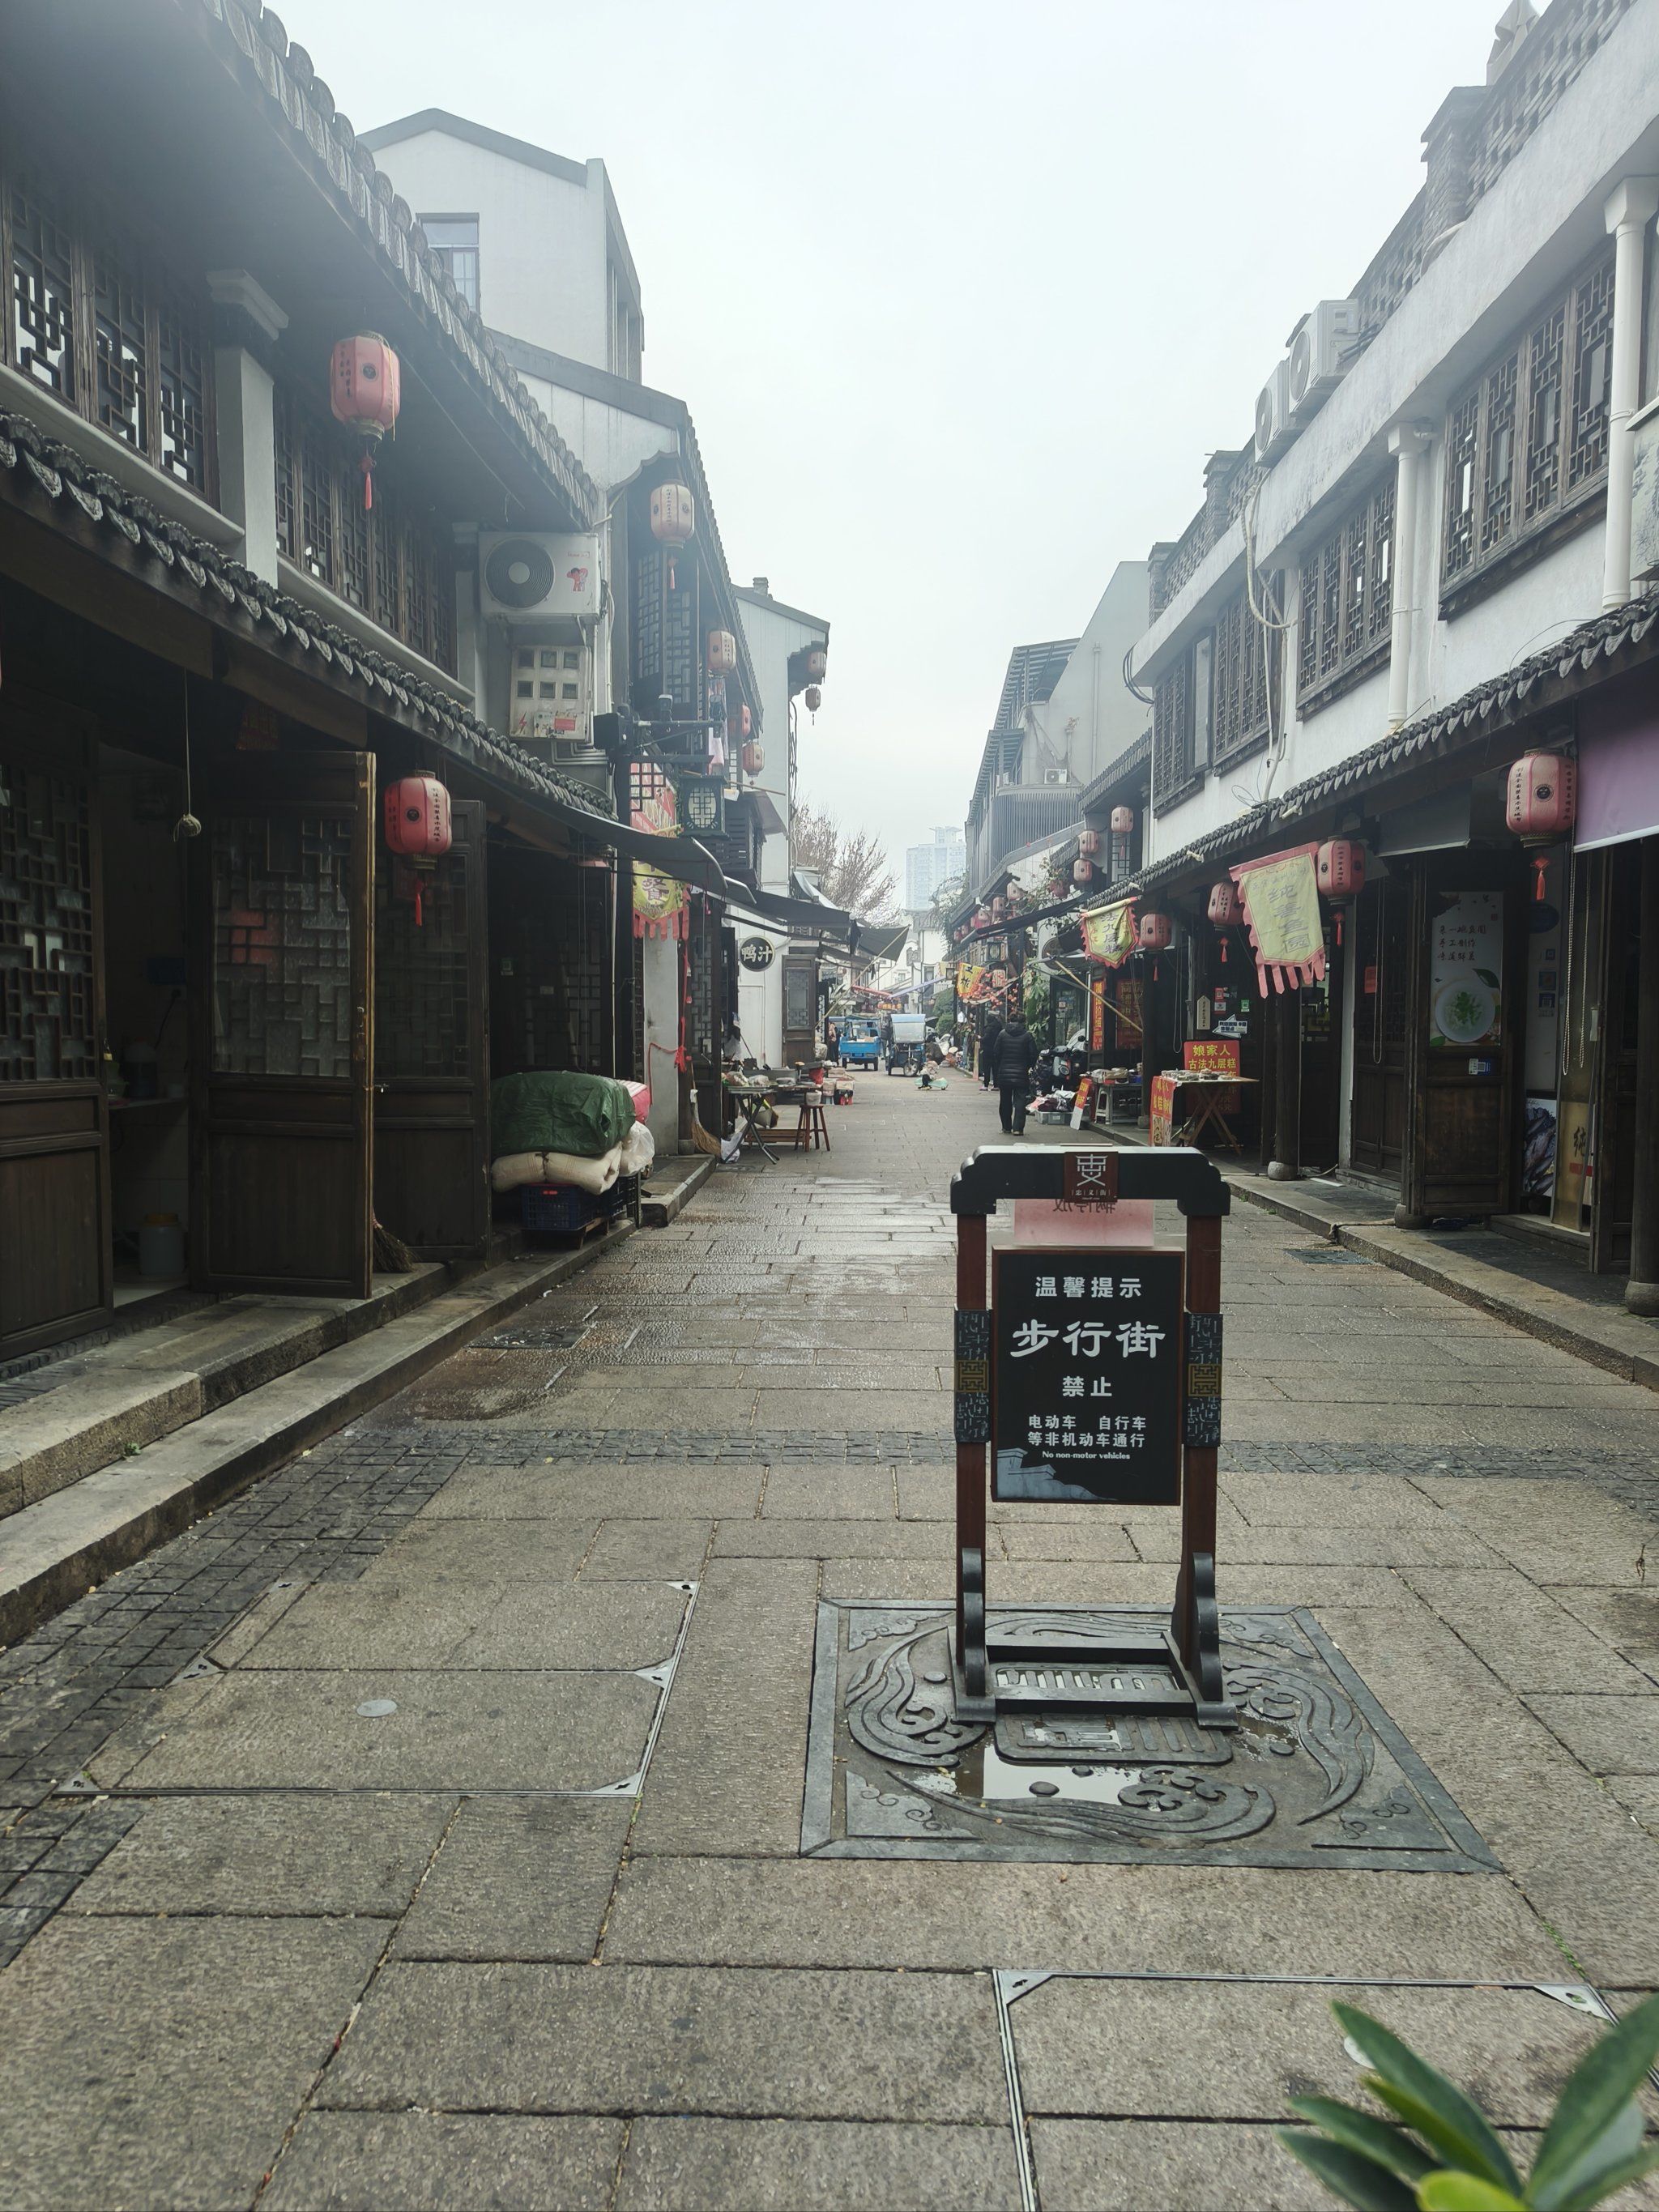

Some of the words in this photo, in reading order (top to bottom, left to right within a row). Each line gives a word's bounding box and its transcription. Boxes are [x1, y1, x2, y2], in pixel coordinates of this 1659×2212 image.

[1192, 1044, 1230, 1056] 娘家人
[1188, 1058, 1236, 1069] 古法九层糕
[1035, 1276, 1141, 1298] 温馨提示
[1010, 1319, 1166, 1358] 步行街
[1062, 1375, 1112, 1397] 禁止
[1029, 1414, 1077, 1430] 电动车
[1098, 1416, 1146, 1430] 自行车
[1027, 1432, 1145, 1447] 等非机动车通行
[1042, 1451, 1054, 1459] No
